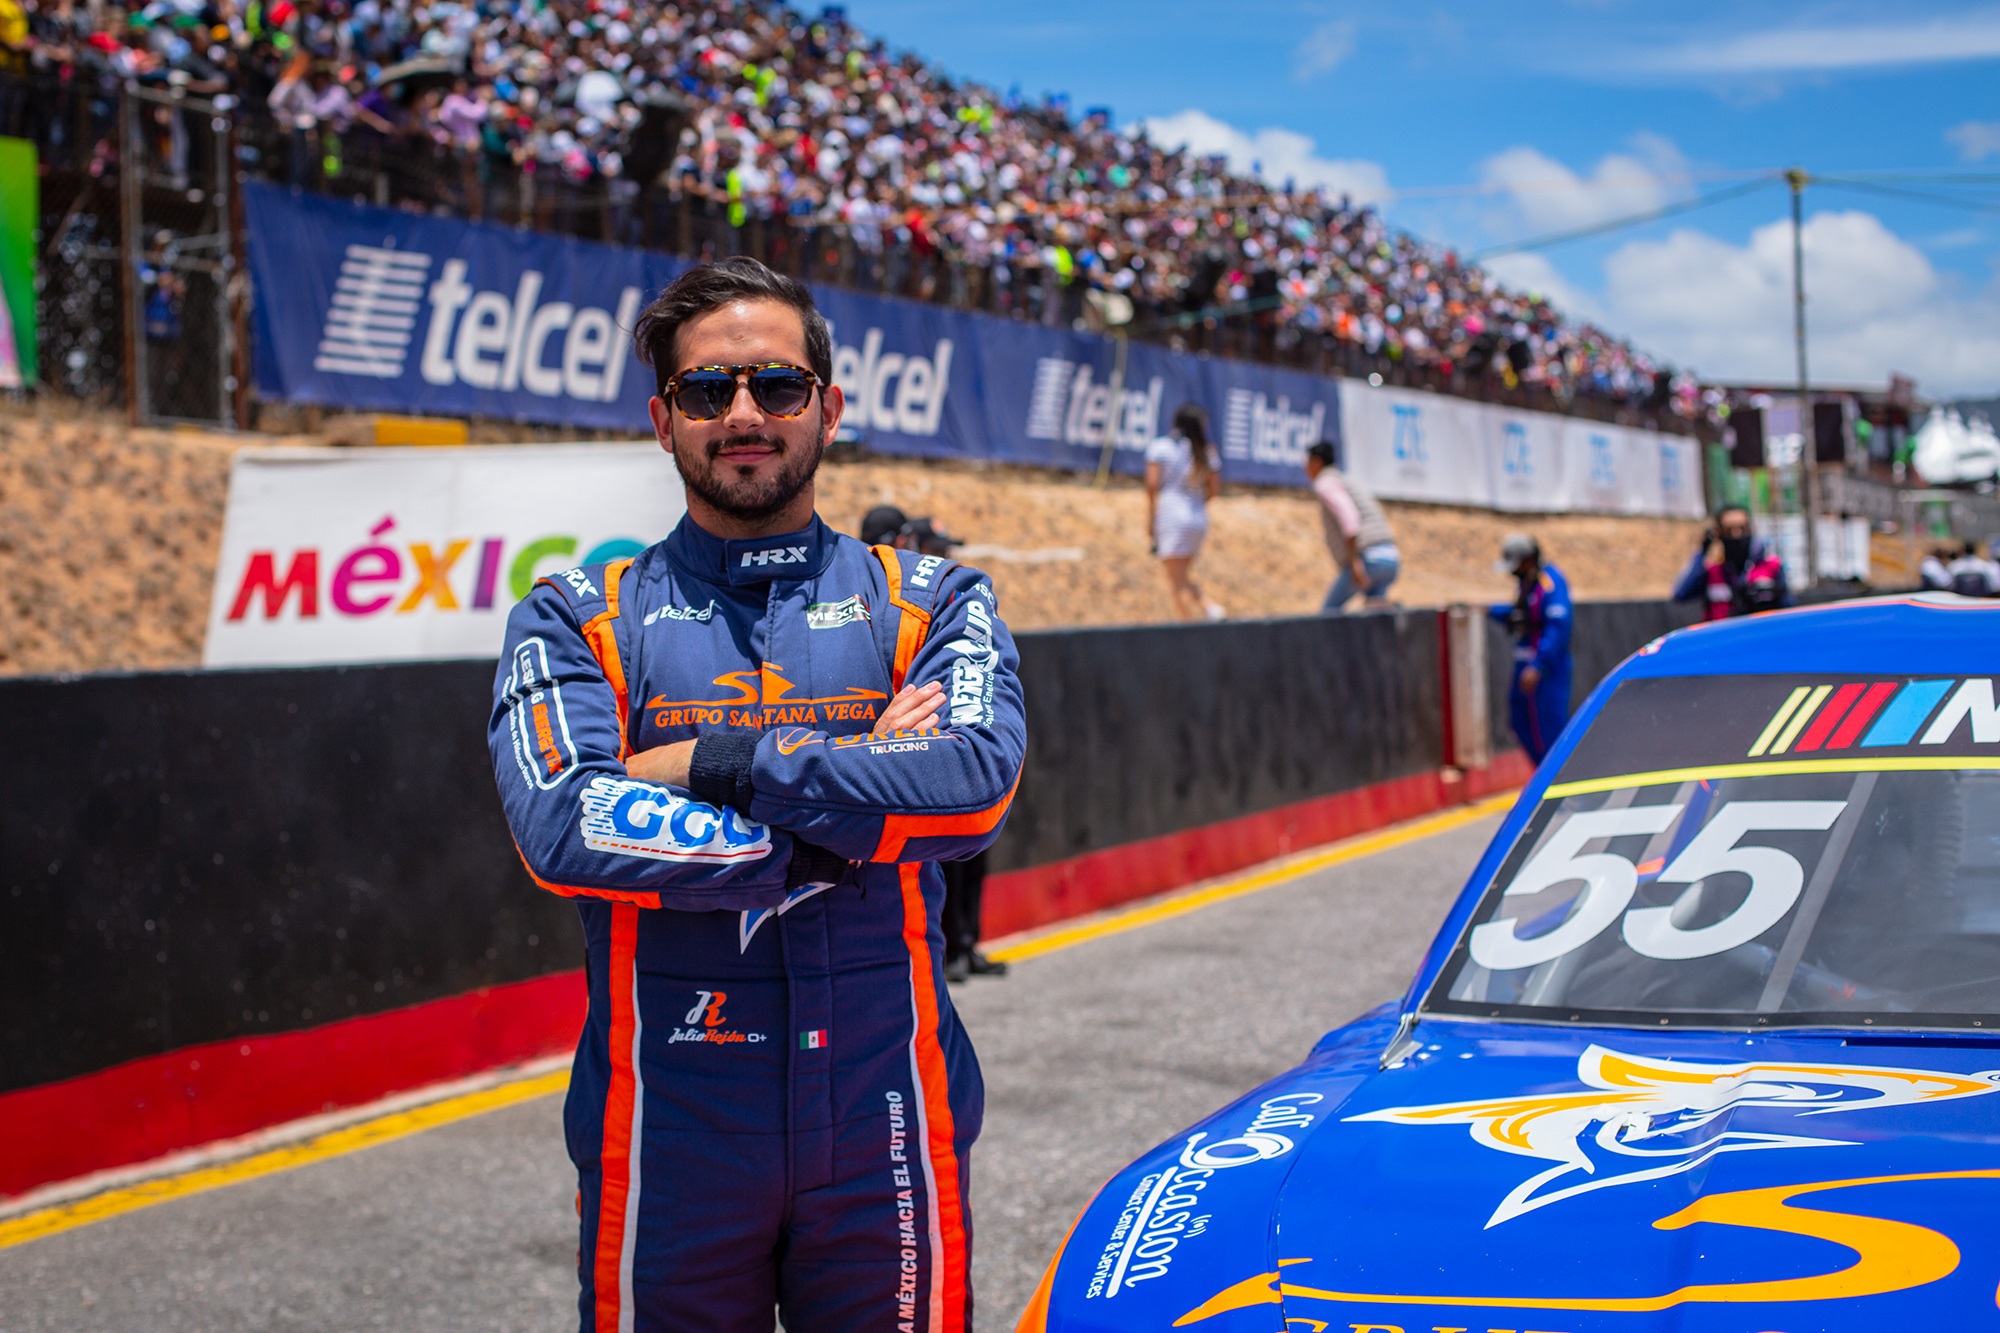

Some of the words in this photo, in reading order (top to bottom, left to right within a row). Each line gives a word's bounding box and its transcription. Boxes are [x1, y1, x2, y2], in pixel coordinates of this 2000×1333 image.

[420, 257, 643, 401] telcel
[740, 546, 808, 567] HRX
[560, 568, 599, 598] RX
[659, 599, 716, 622] telcel
[655, 707, 723, 728] GRUPO
[729, 705, 818, 729] SANTANA
[823, 703, 876, 721] VEGA
[869, 741, 929, 754] TRUCKING
[1469, 801, 1847, 970] 55
[885, 1090, 907, 1162] FUTURO
[1244, 1092, 1324, 1137] Call
[892, 1163, 912, 1188] EL
[1125, 1173, 1162, 1208] Contact
[896, 1189, 917, 1247] HACIA
[1110, 1204, 1141, 1241] Center
[1104, 1240, 1124, 1253] &
[895, 1249, 918, 1320] MÉXICO
[1085, 1250, 1121, 1299] Services
